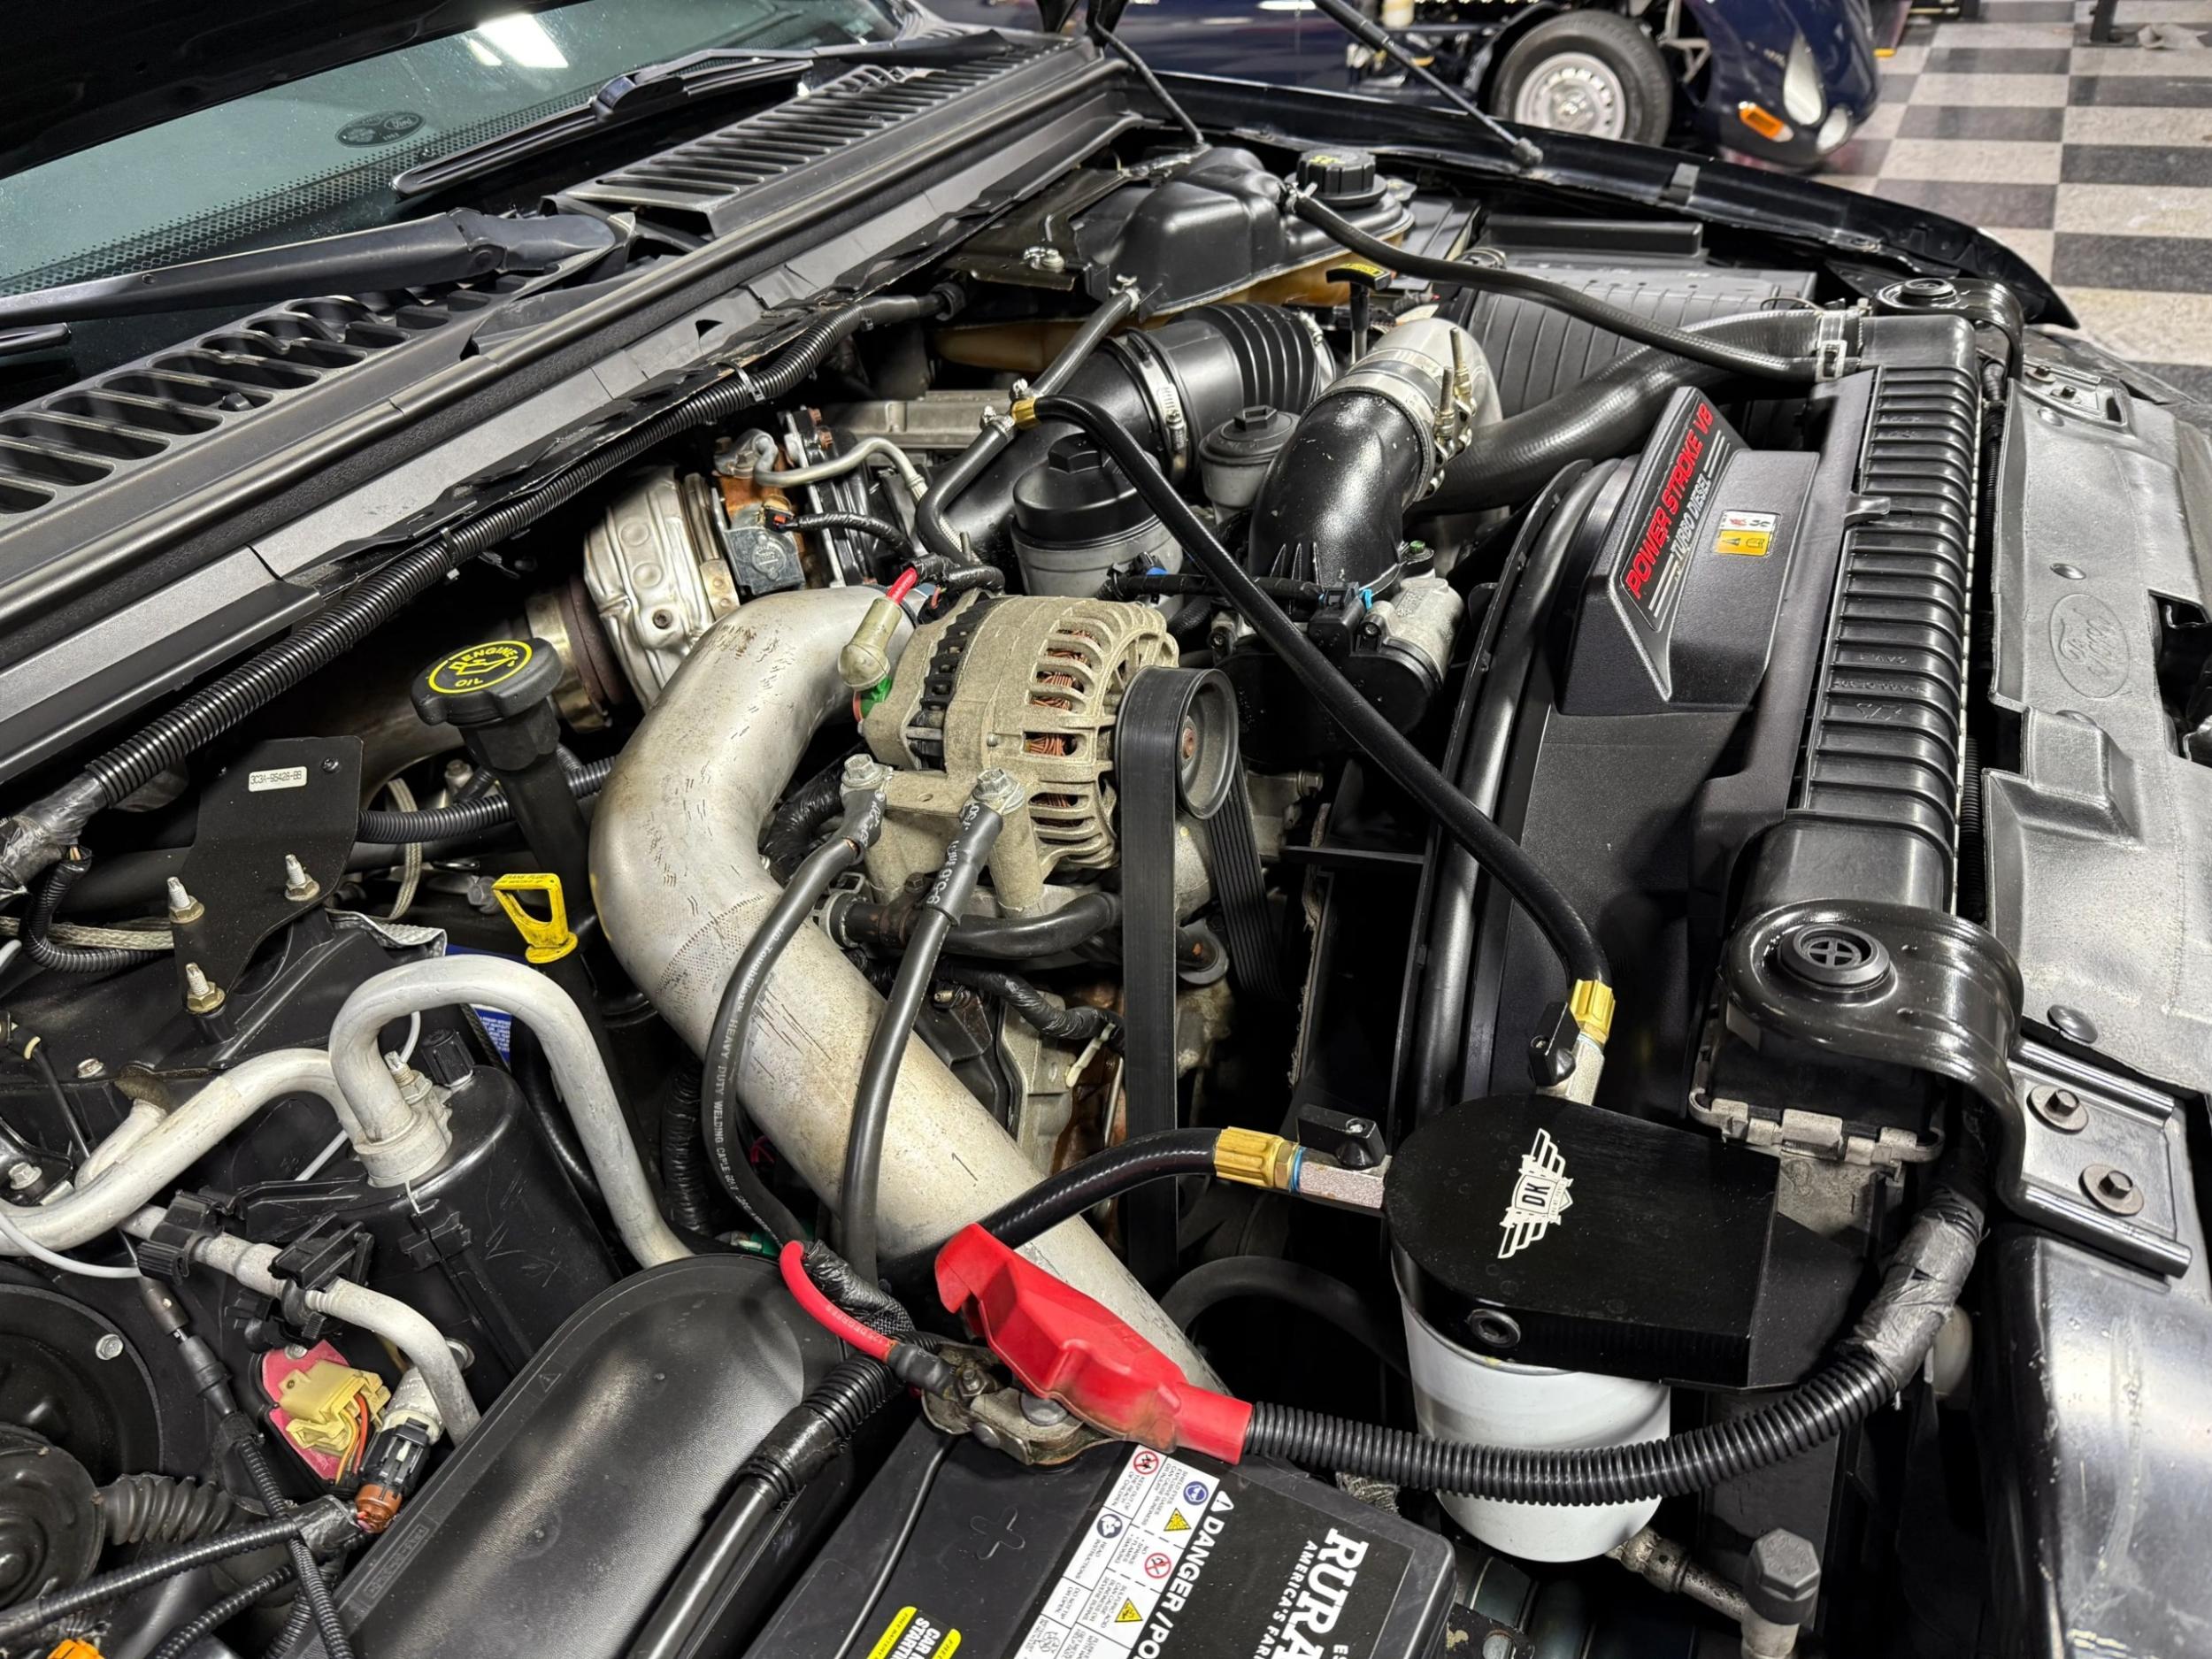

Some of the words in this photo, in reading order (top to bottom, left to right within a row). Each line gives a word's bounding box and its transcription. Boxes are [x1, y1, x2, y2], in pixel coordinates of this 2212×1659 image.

[1625, 506, 1671, 600] POWER
[1662, 428, 1703, 515] STROKE
[1694, 403, 1714, 434] V8
[1671, 513, 1696, 560] TURBO
[1686, 473, 1711, 519] DIESEL
[461, 646, 518, 661] ENGINE
[455, 678, 483, 687] OIL
[720, 1018, 739, 1060] HEAVY
[715, 1065, 727, 1095] DUTY
[713, 1100, 724, 1143] WELDING
[1521, 1182, 1551, 1208] DK
[825, 1303, 868, 1336] DEGREES
[1094, 1540, 1107, 1557] READ
[1141, 1545, 1148, 1555] NO
[1161, 1516, 1225, 1612] DANGER
[1071, 1586, 1079, 1597] DO
[1272, 1540, 1318, 1623] AMERICA'S
[1064, 1597, 1074, 1610] NOT
[915, 1628, 941, 1655] CAR
[1252, 1625, 1280, 1659] FAR
